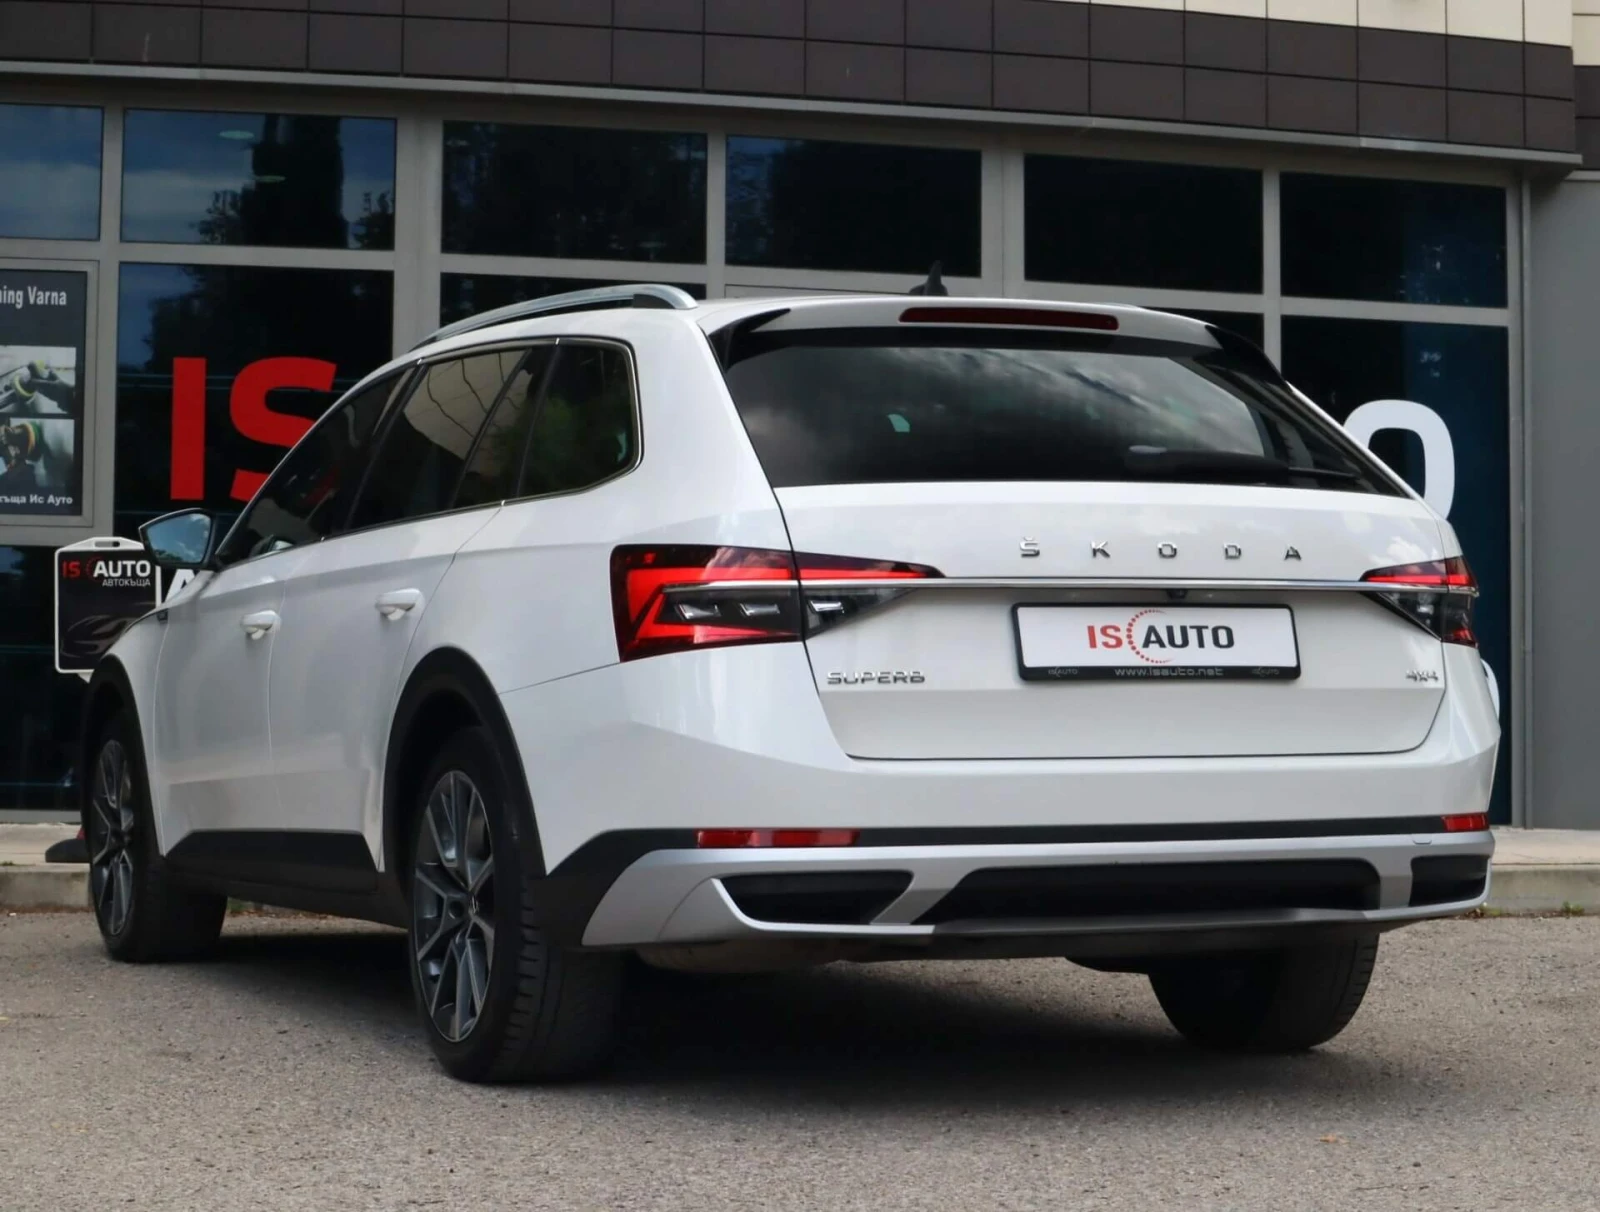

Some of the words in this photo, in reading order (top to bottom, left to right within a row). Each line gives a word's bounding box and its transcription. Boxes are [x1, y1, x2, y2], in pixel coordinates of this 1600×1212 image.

[0, 285, 24, 309] ing
[27, 286, 68, 306] Varna
[170, 356, 338, 503] IS
[29, 494, 45, 504] Ис
[47, 494, 74, 506] Ауто
[1019, 536, 1303, 561] ŠKODA
[62, 561, 81, 578] IS
[93, 560, 152, 578] AUTO
[102, 578, 152, 588] АВТОКЪЩА
[1087, 625, 1124, 649] IS
[1142, 625, 1235, 649] AUTO
[826, 670, 926, 685] SUPERB
[1114, 667, 1224, 677] www.isauto.net
